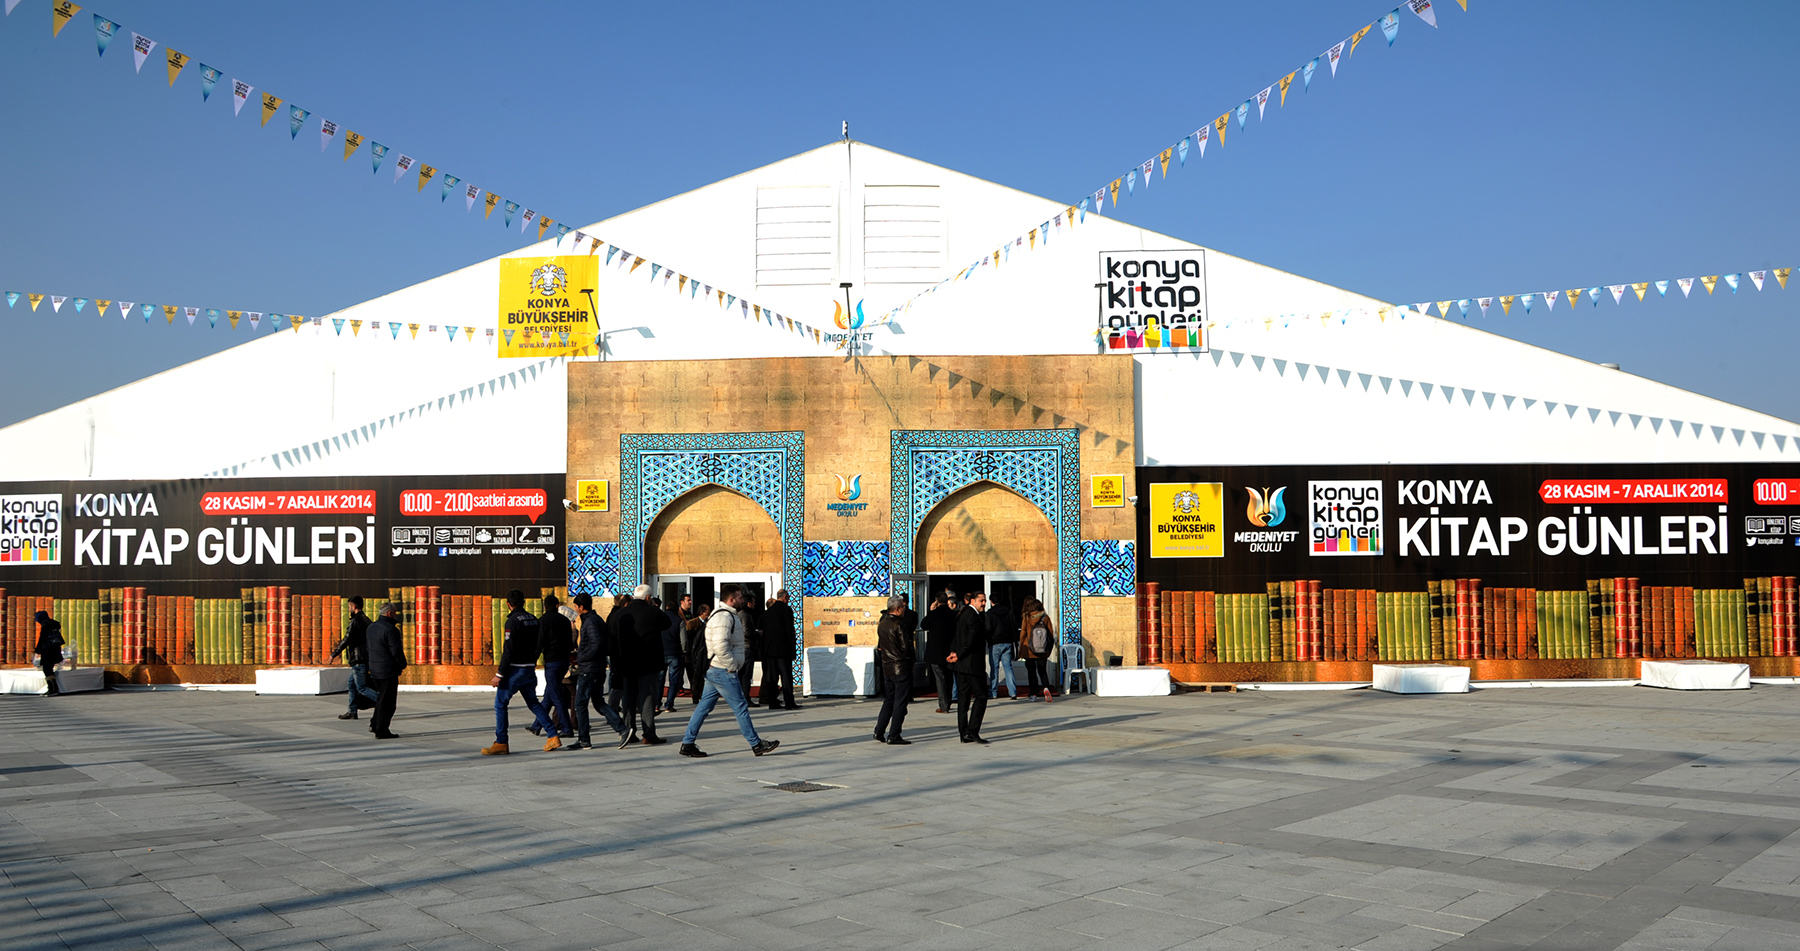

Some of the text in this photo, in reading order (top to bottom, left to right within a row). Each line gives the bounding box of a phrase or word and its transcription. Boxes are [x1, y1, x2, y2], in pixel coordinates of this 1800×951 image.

[1106, 256, 1200, 284] konya
[528, 298, 570, 308] KONYA
[1107, 280, 1201, 312] kitap
[508, 308, 588, 325] BÜYÜKŞEHİR
[1313, 484, 1378, 505] konya
[1398, 480, 1493, 505] KONYA
[1544, 485, 1561, 499] 28
[1564, 484, 1610, 498] KASIM
[1622, 484, 1632, 498] 7
[1633, 484, 1688, 498] ARALIK
[1689, 483, 1724, 498] 2014
[1756, 482, 1786, 501] 10.00
[2, 498, 59, 518] konya
[75, 492, 159, 517] KONYA
[204, 496, 221, 510] 28
[223, 495, 266, 510] KASIM
[277, 495, 286, 509] 7
[287, 494, 338, 509] ARALIK
[340, 494, 373, 508] 2014
[403, 493, 432, 512] 10.00
[444, 493, 473, 512] 21.00
[473, 493, 506, 507] saatleri
[507, 492, 544, 507] arasında
[1313, 502, 1379, 526] kitap
[1, 514, 58, 537] kitap
[1158, 522, 1216, 534] BÜYÜKŞEHİR
[1313, 524, 1379, 543] günleri
[1398, 505, 1729, 557] KİTAP GÜNLERİ
[1, 535, 58, 553] günleri
[74, 515, 375, 566] KİTAP GÜNLERİ
[1250, 542, 1282, 553] OKULU
